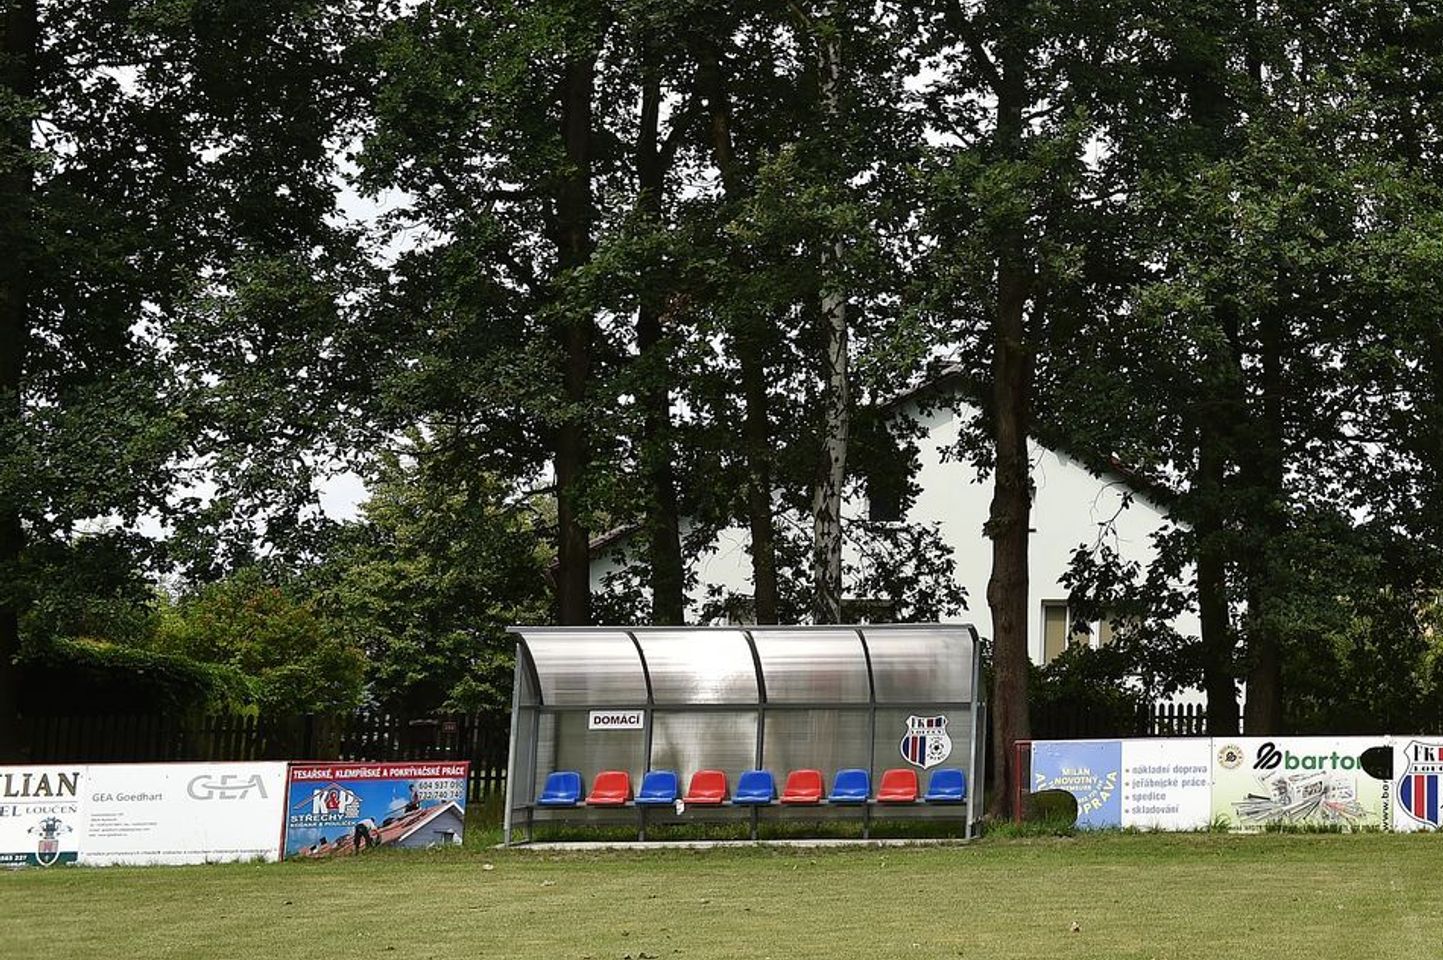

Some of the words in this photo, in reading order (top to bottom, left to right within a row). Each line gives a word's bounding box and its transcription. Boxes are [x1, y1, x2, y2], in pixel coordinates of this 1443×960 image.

[594, 714, 640, 725] DOMÁCÍ
[1414, 744, 1435, 761] FK
[335, 767, 381, 778] KLEMPÍŘSKÉ
[390, 766, 441, 777] POKRÝVAČSKÉ
[442, 765, 465, 776] PRÁCE
[1061, 767, 1091, 776] MILAN
[1132, 764, 1171, 774] nákladní
[1173, 764, 1208, 775] doprava
[0, 772, 80, 797] LIAN
[419, 781, 432, 789] 604
[1054, 776, 1099, 785] NOVOTNÝ
[1132, 778, 1179, 789] jeřábnické
[1182, 778, 1207, 789] práce
[187, 774, 268, 800] GEA
[92, 793, 113, 802] GEA
[116, 792, 163, 802] Goedhart
[313, 789, 354, 814] K&P
[1132, 791, 1166, 802] spedice
[1132, 804, 1180, 815] skladování
[290, 813, 343, 822] STŘECHY
